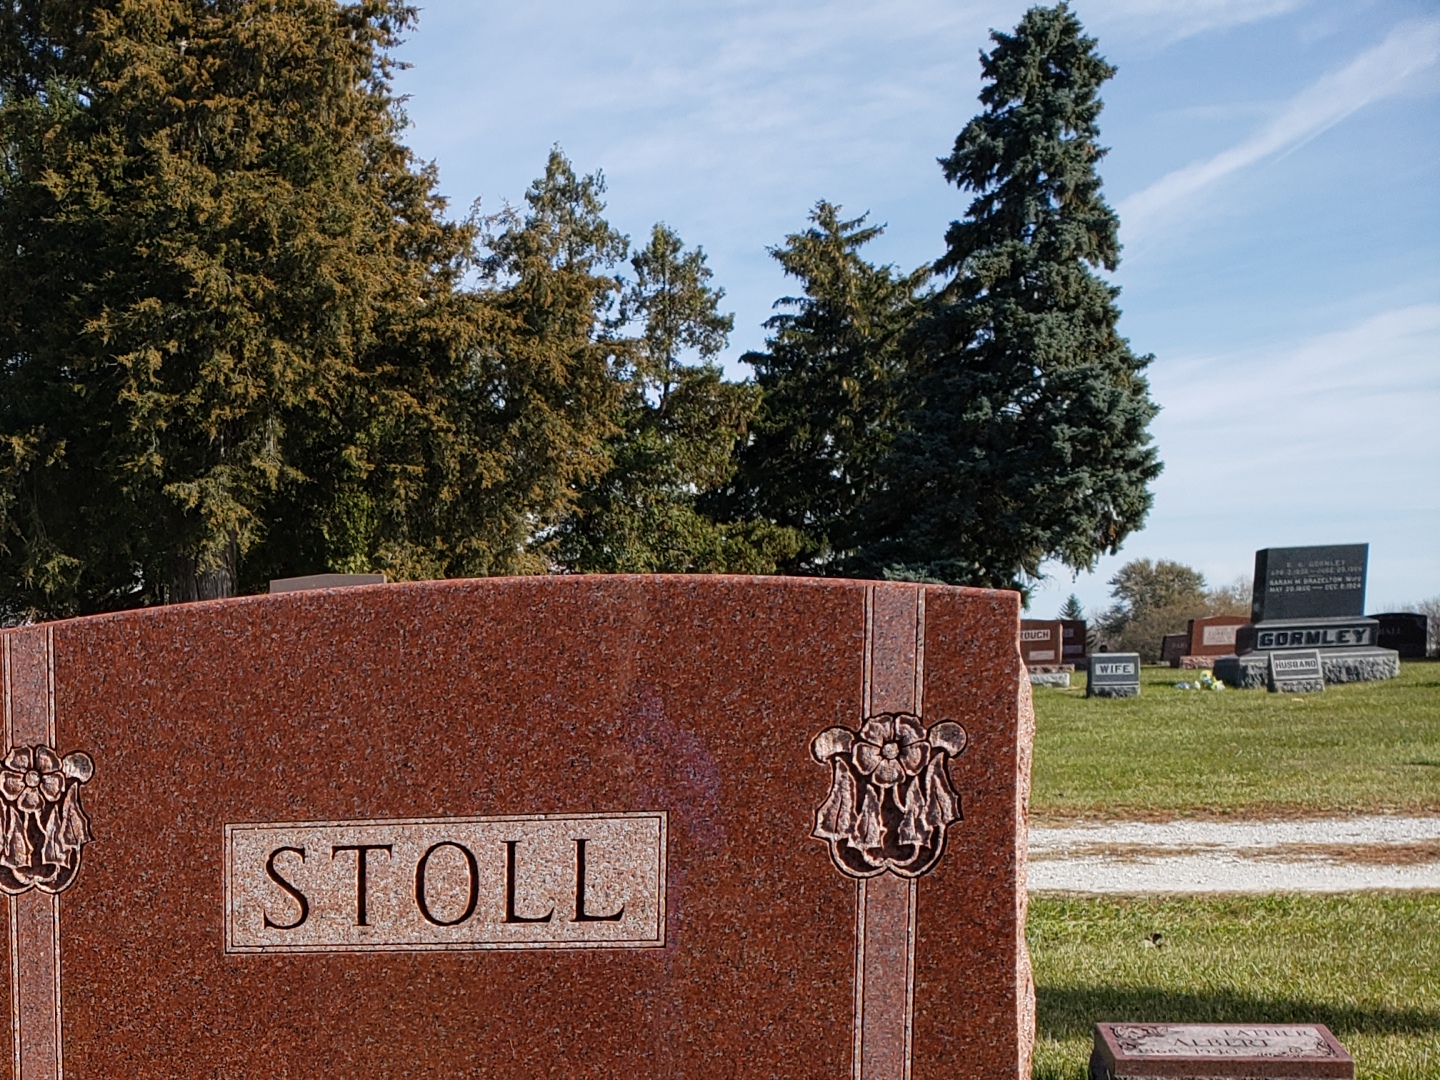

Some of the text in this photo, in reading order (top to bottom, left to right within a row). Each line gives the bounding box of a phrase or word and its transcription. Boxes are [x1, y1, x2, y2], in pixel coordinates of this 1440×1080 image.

[1259, 628, 1367, 647] GORMLEY
[1100, 664, 1131, 674] WIFE
[1275, 659, 1317, 669] HUSBAND
[262, 837, 625, 931] STOLL
[1223, 1029, 1312, 1037] FATHER
[1173, 1038, 1272, 1048] ALBERT
